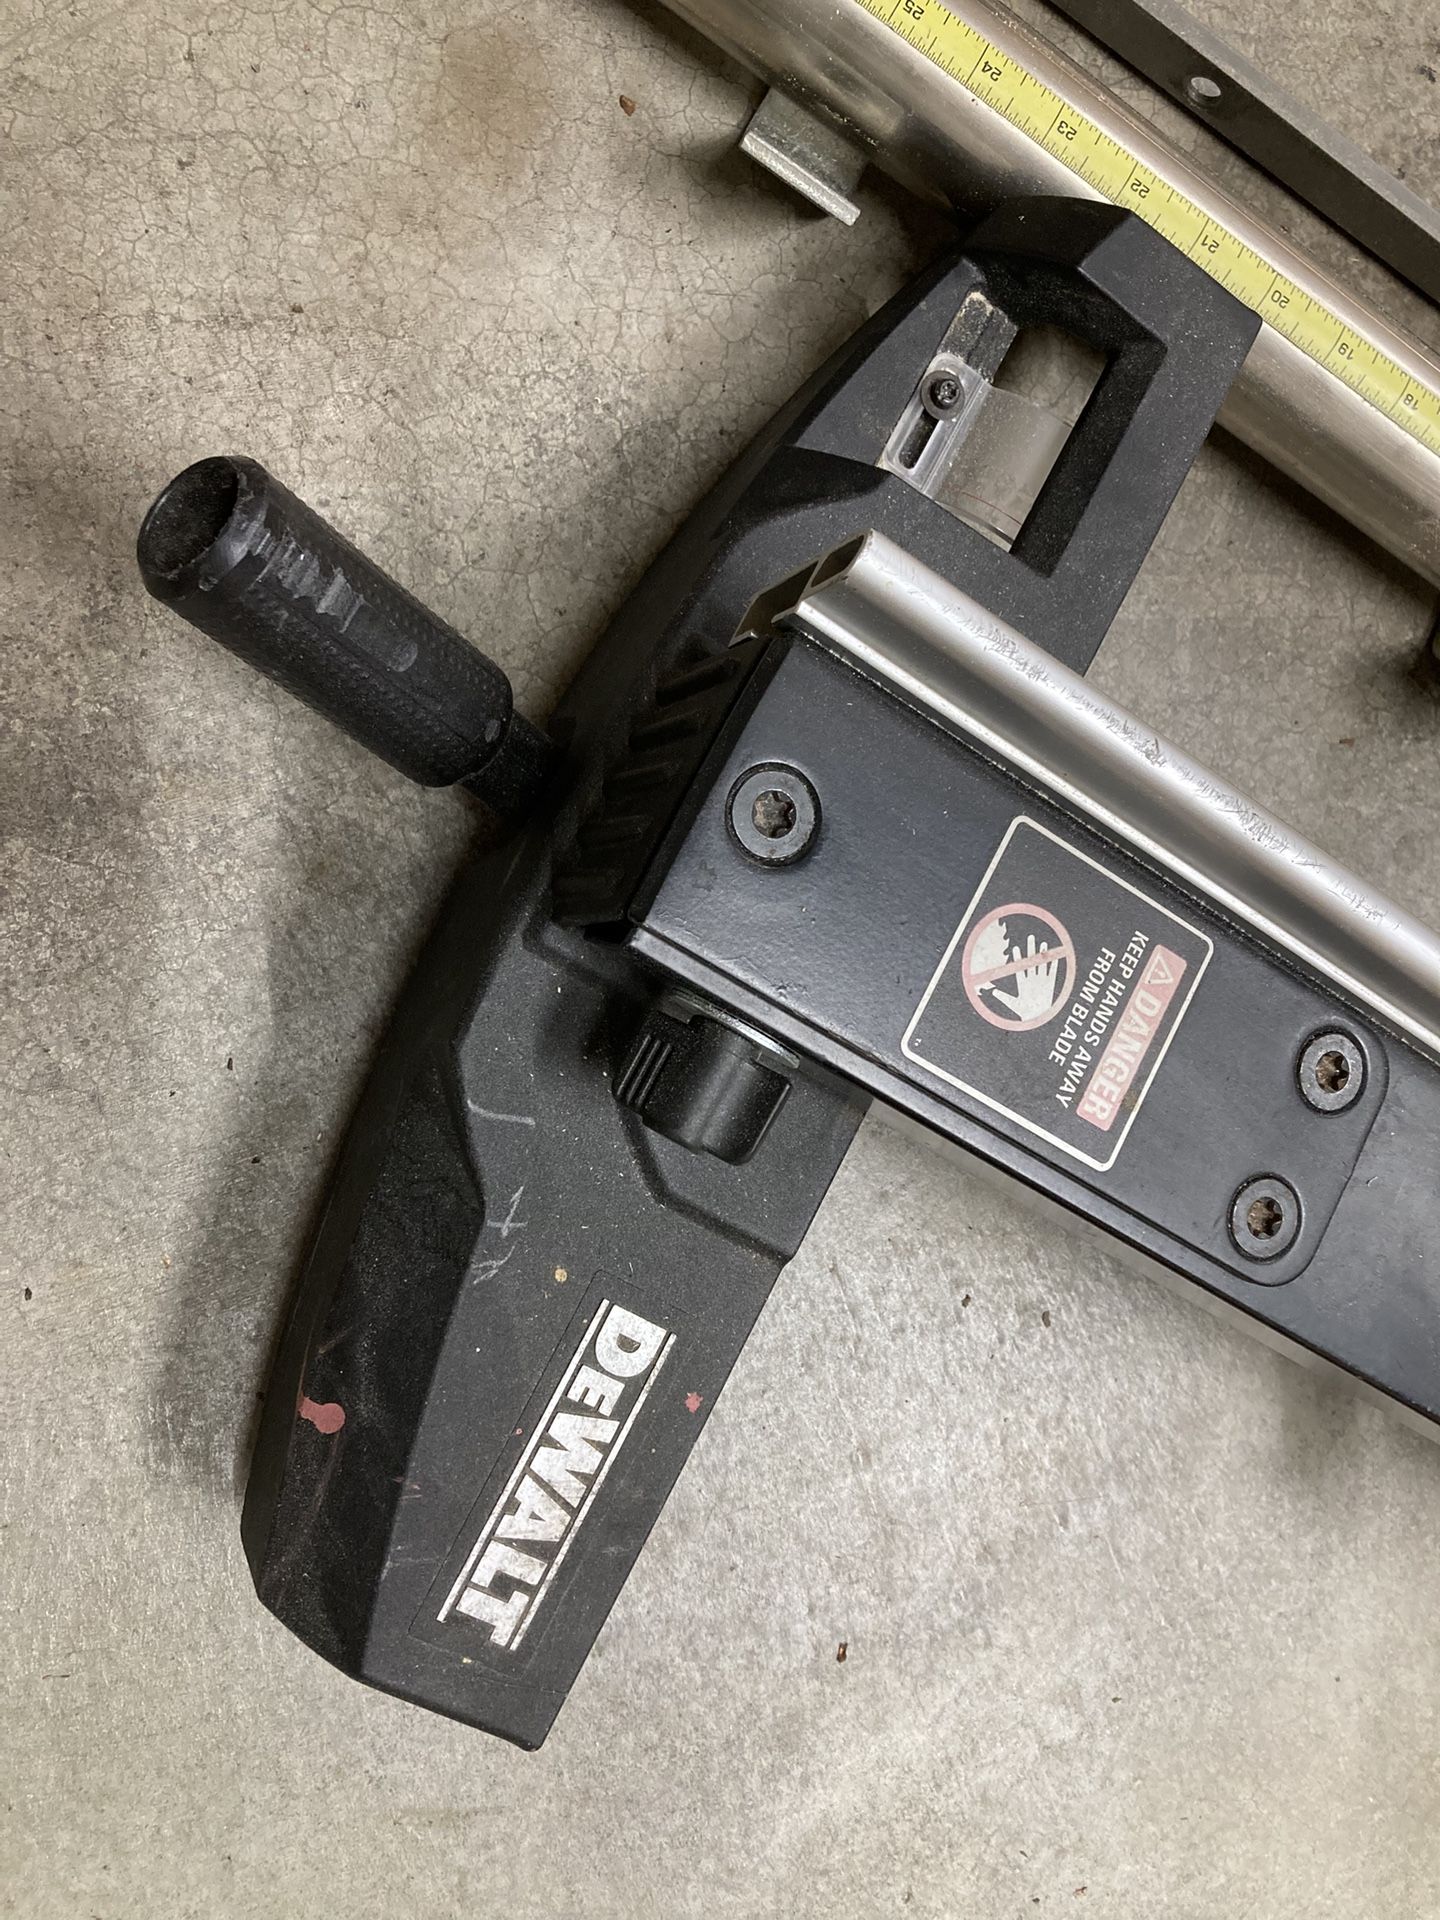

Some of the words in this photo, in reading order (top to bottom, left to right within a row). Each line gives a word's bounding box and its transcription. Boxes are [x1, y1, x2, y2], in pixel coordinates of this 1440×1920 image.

[902, 0, 925, 20] 25
[981, 60, 1003, 82] 24
[1056, 120, 1077, 141] 23
[1130, 178, 1151, 199] 22
[1201, 234, 1220, 254] 21
[1271, 289, 1290, 309] 20
[1337, 342, 1355, 361] 19
[1403, 393, 1419, 411] 18
[1118, 930, 1150, 980] KEEP
[1079, 947, 1116, 1004] FROM
[1083, 978, 1126, 1047] HANDS
[1048, 1002, 1090, 1067] BLADE
[1083, 990, 1160, 1122] DANGER
[1055, 1046, 1092, 1109] AWAY
[456, 1304, 668, 1647] DEWALT
